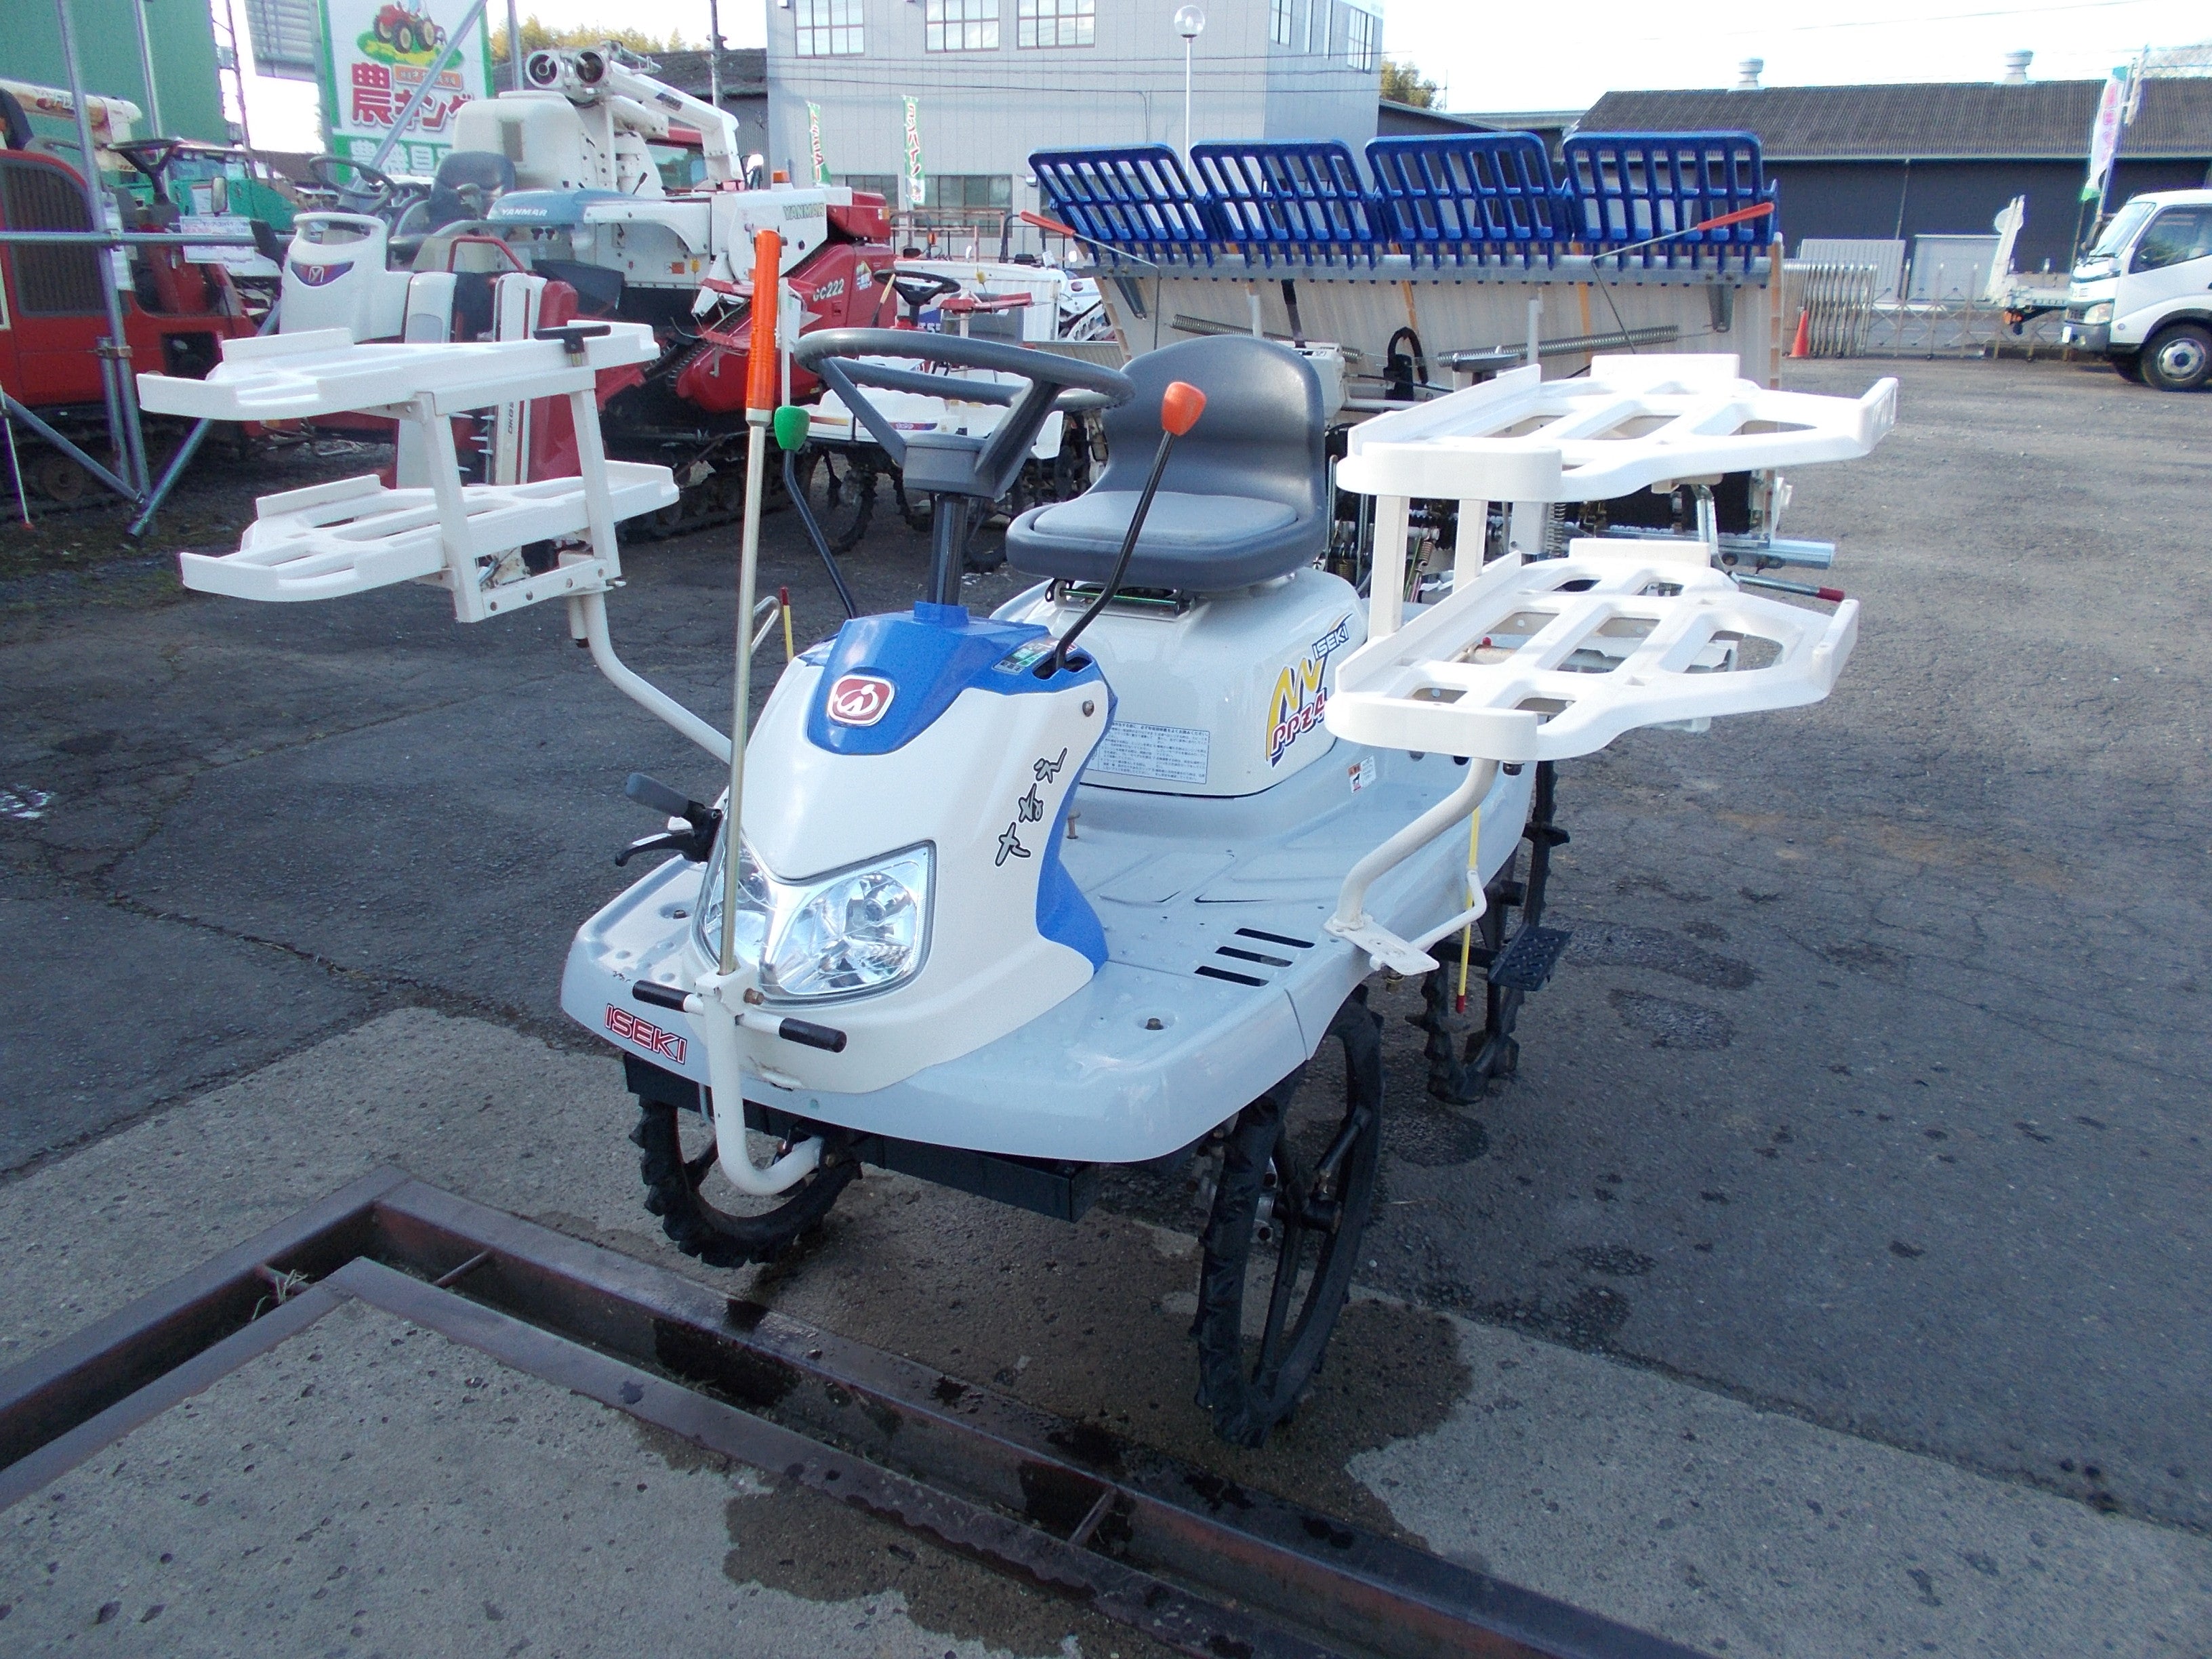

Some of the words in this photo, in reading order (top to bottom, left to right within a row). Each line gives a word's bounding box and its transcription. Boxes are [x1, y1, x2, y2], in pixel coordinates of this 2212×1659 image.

[501, 208, 548, 217] YANMAR
[783, 202, 825, 221] YANMAR
[1311, 623, 1350, 662] ISEKI
[605, 1002, 688, 1065] ISEKI
